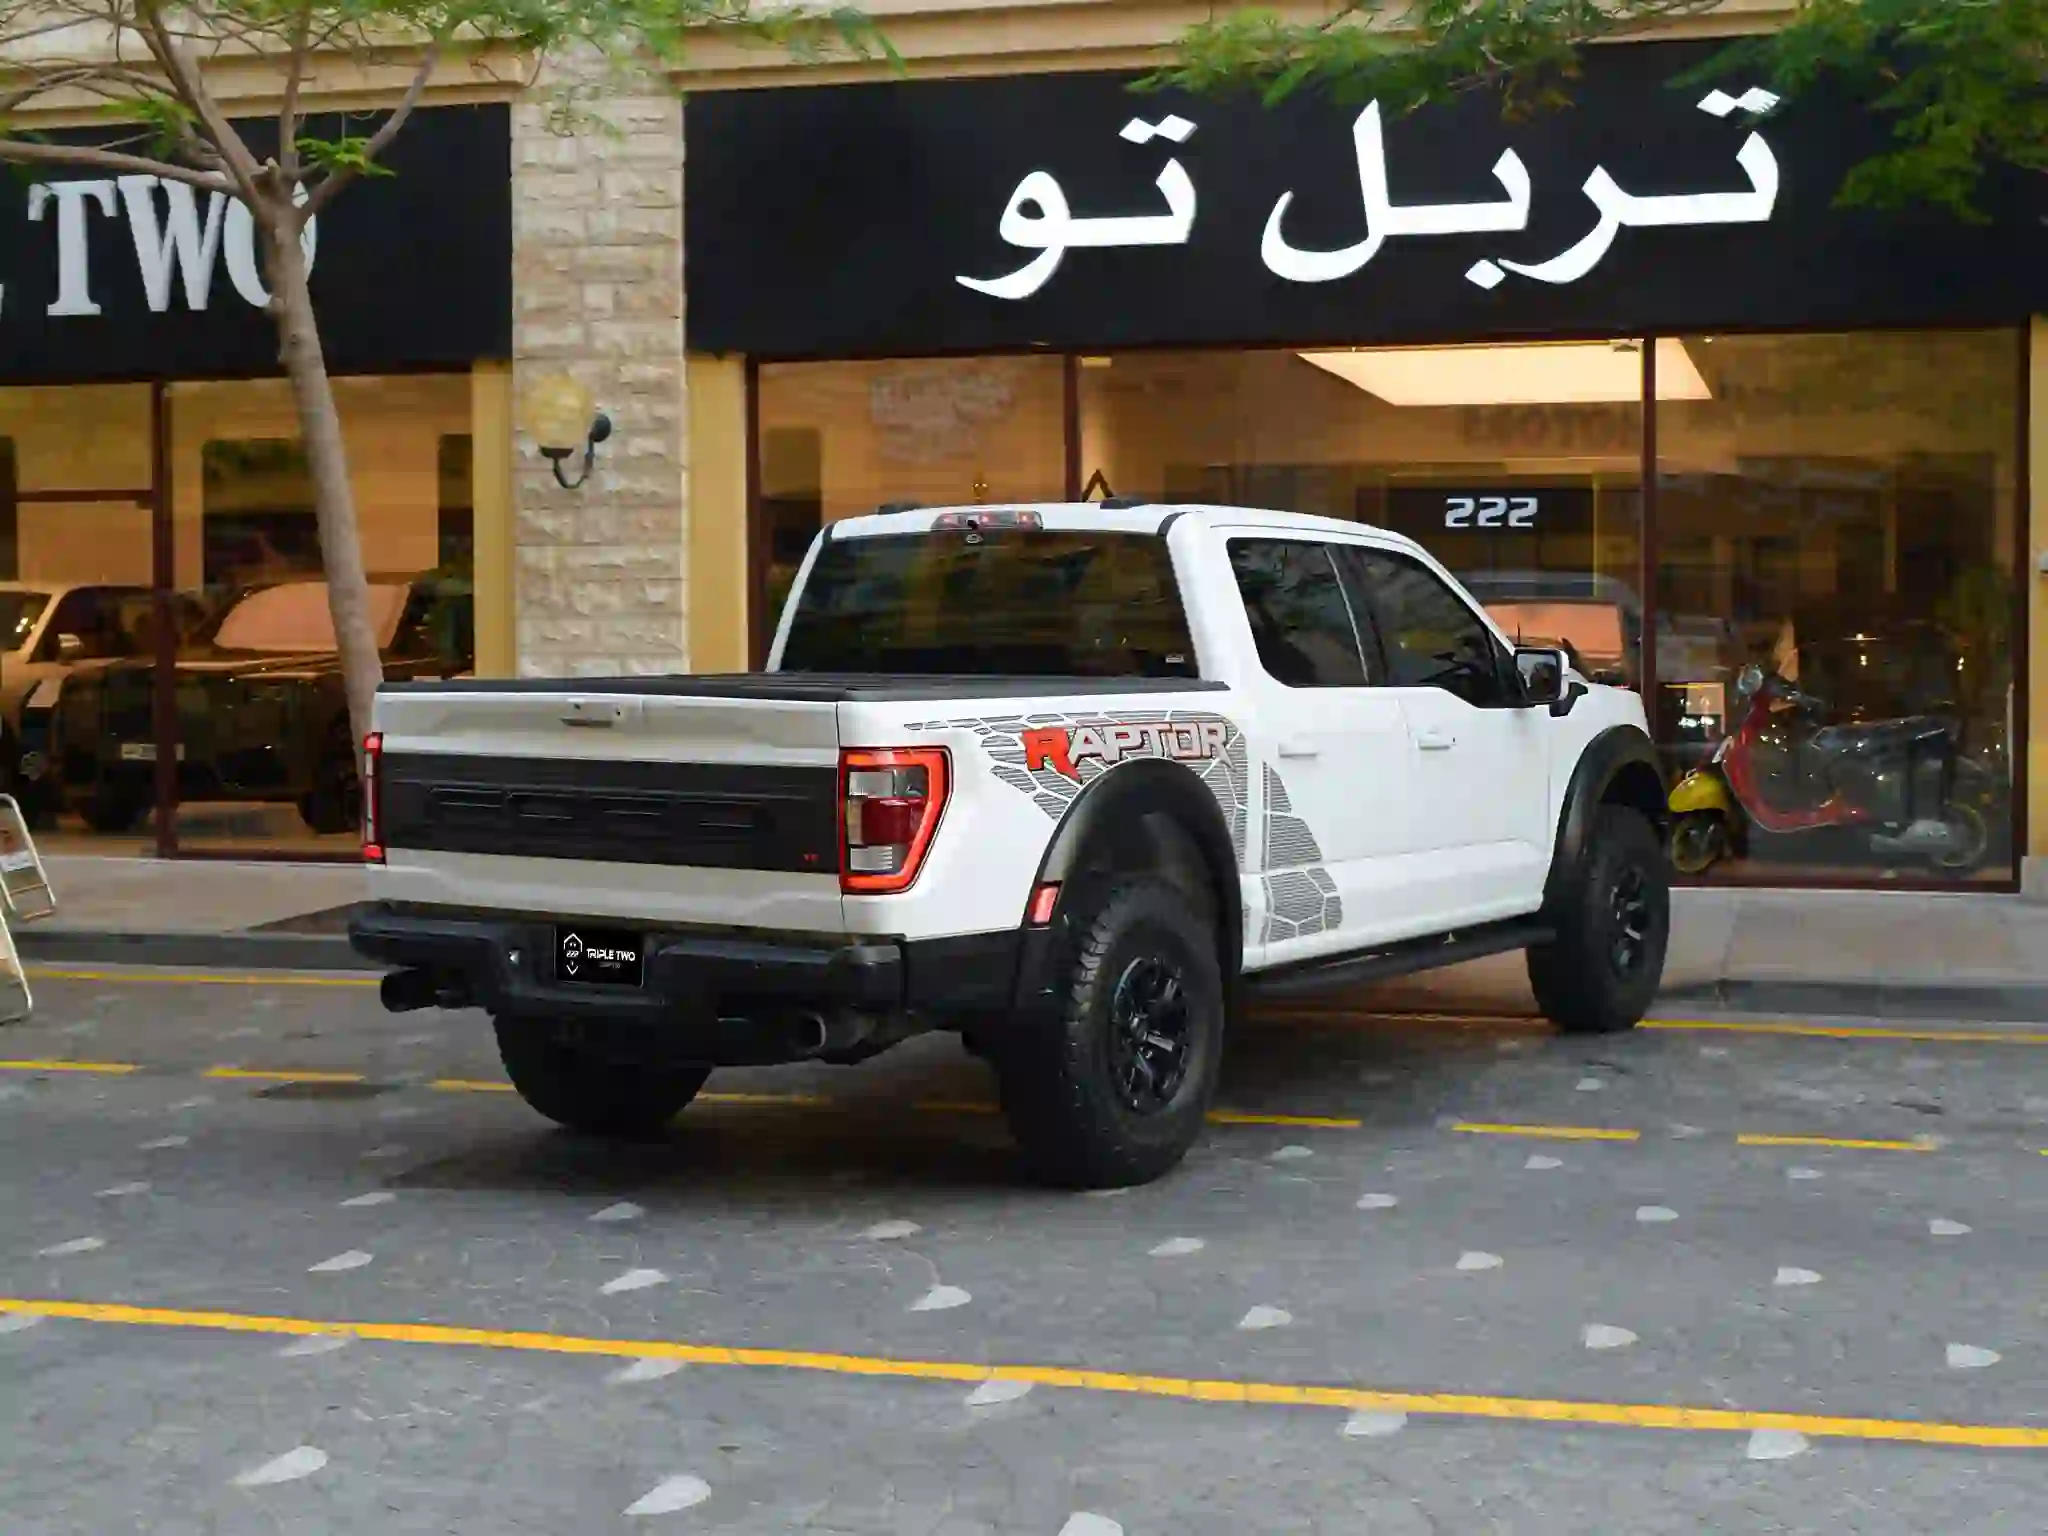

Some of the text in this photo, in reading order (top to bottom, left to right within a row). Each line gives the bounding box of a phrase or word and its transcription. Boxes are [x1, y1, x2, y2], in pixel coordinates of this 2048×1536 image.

[955, 87, 1781, 300] تربل تو
[1444, 497, 1538, 528] 222
[1021, 720, 1236, 784] RAPTOR
[586, 948, 636, 962] TRIPLE TWO
